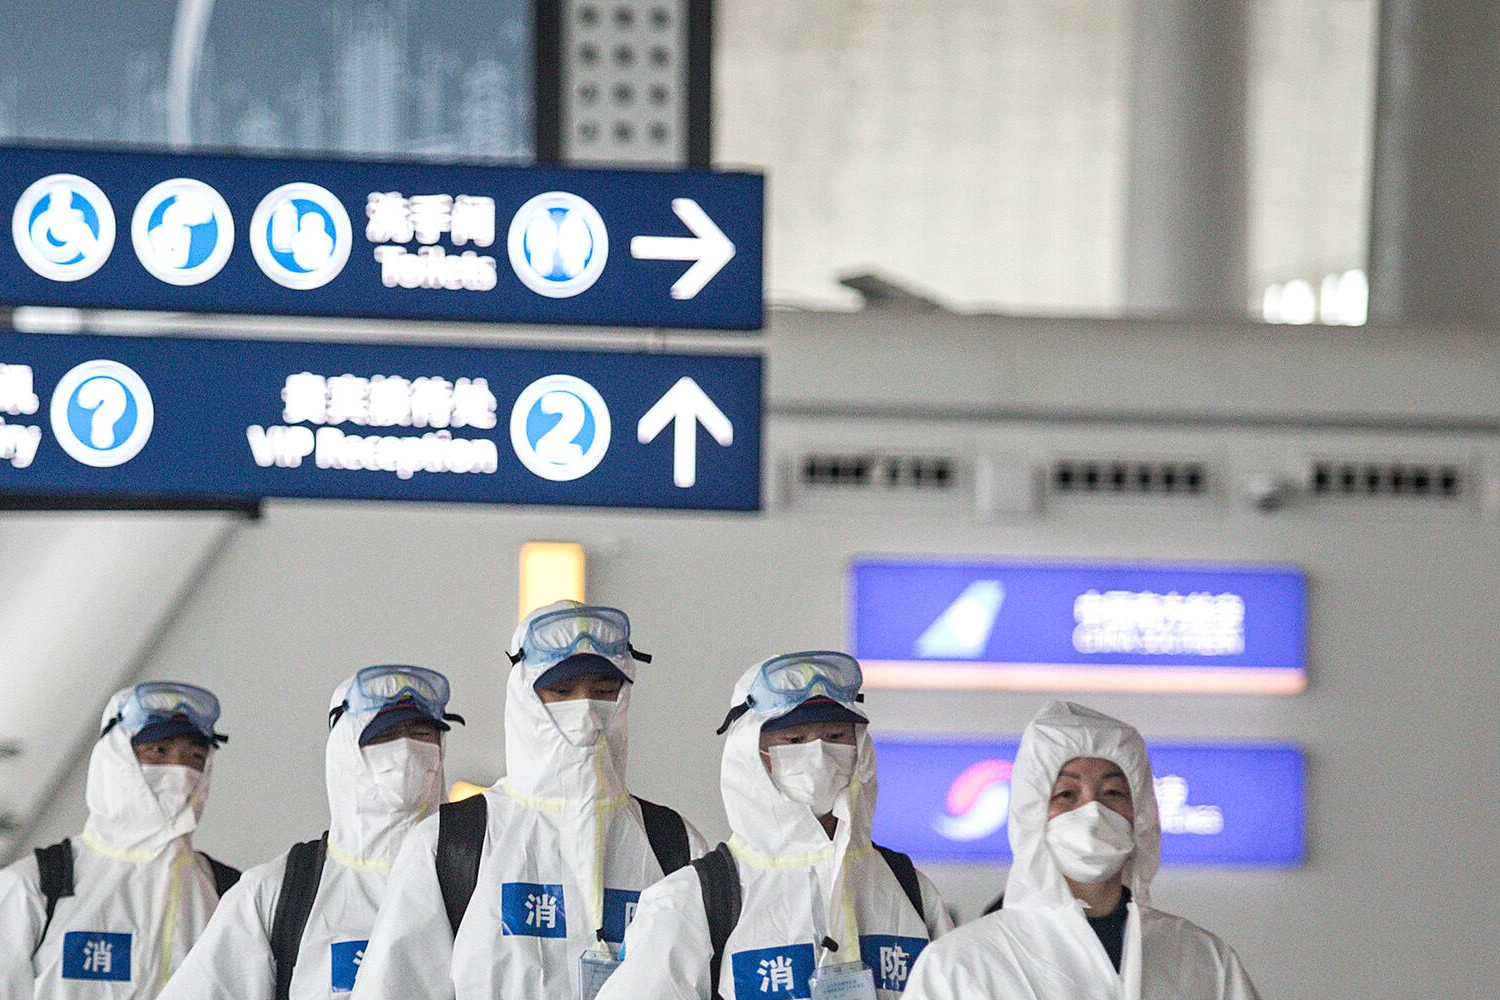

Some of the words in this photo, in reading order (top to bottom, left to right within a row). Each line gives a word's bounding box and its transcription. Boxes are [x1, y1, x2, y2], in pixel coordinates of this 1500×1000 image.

[374, 245, 498, 291] Toilets
[246, 424, 315, 468] VIP
[315, 427, 498, 480] Reception
[525, 893, 557, 928] 消
[82, 939, 113, 974] 消
[756, 955, 795, 993] 消
[879, 941, 910, 982] 防
